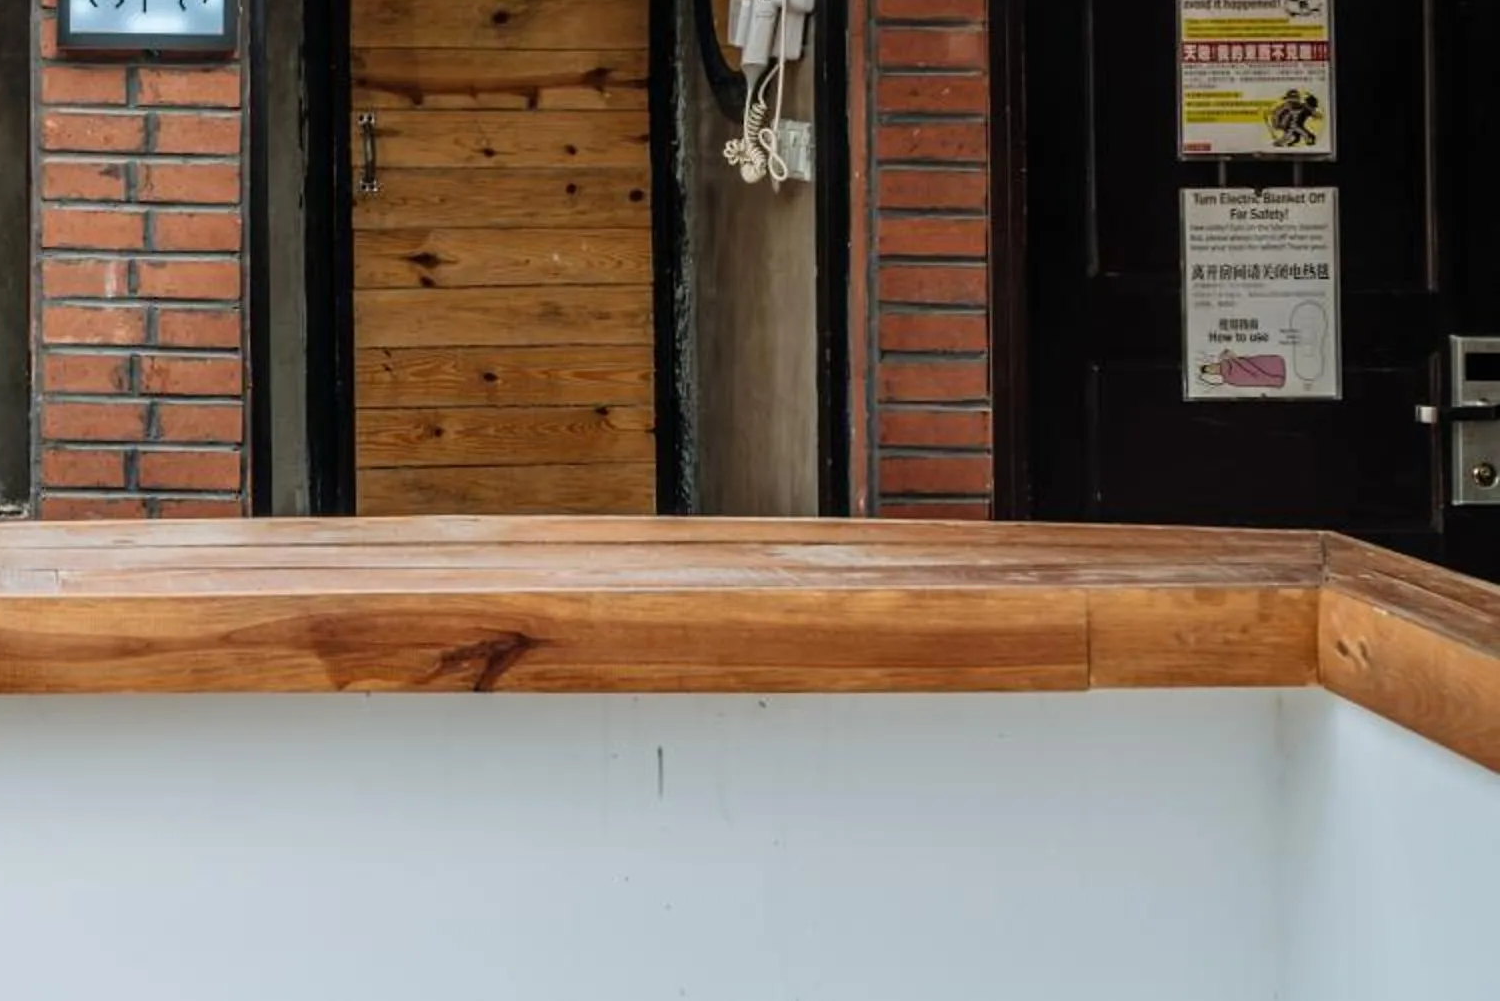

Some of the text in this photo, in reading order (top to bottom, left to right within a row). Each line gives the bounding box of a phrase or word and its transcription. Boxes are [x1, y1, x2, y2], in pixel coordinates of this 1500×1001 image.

[1194, 192, 1326, 205] Turn Electric Blanket Off
[1230, 208, 1289, 222] For Safety!
[1208, 331, 1232, 343] How
[1235, 333, 1247, 343] to
[1249, 333, 1269, 343] use
